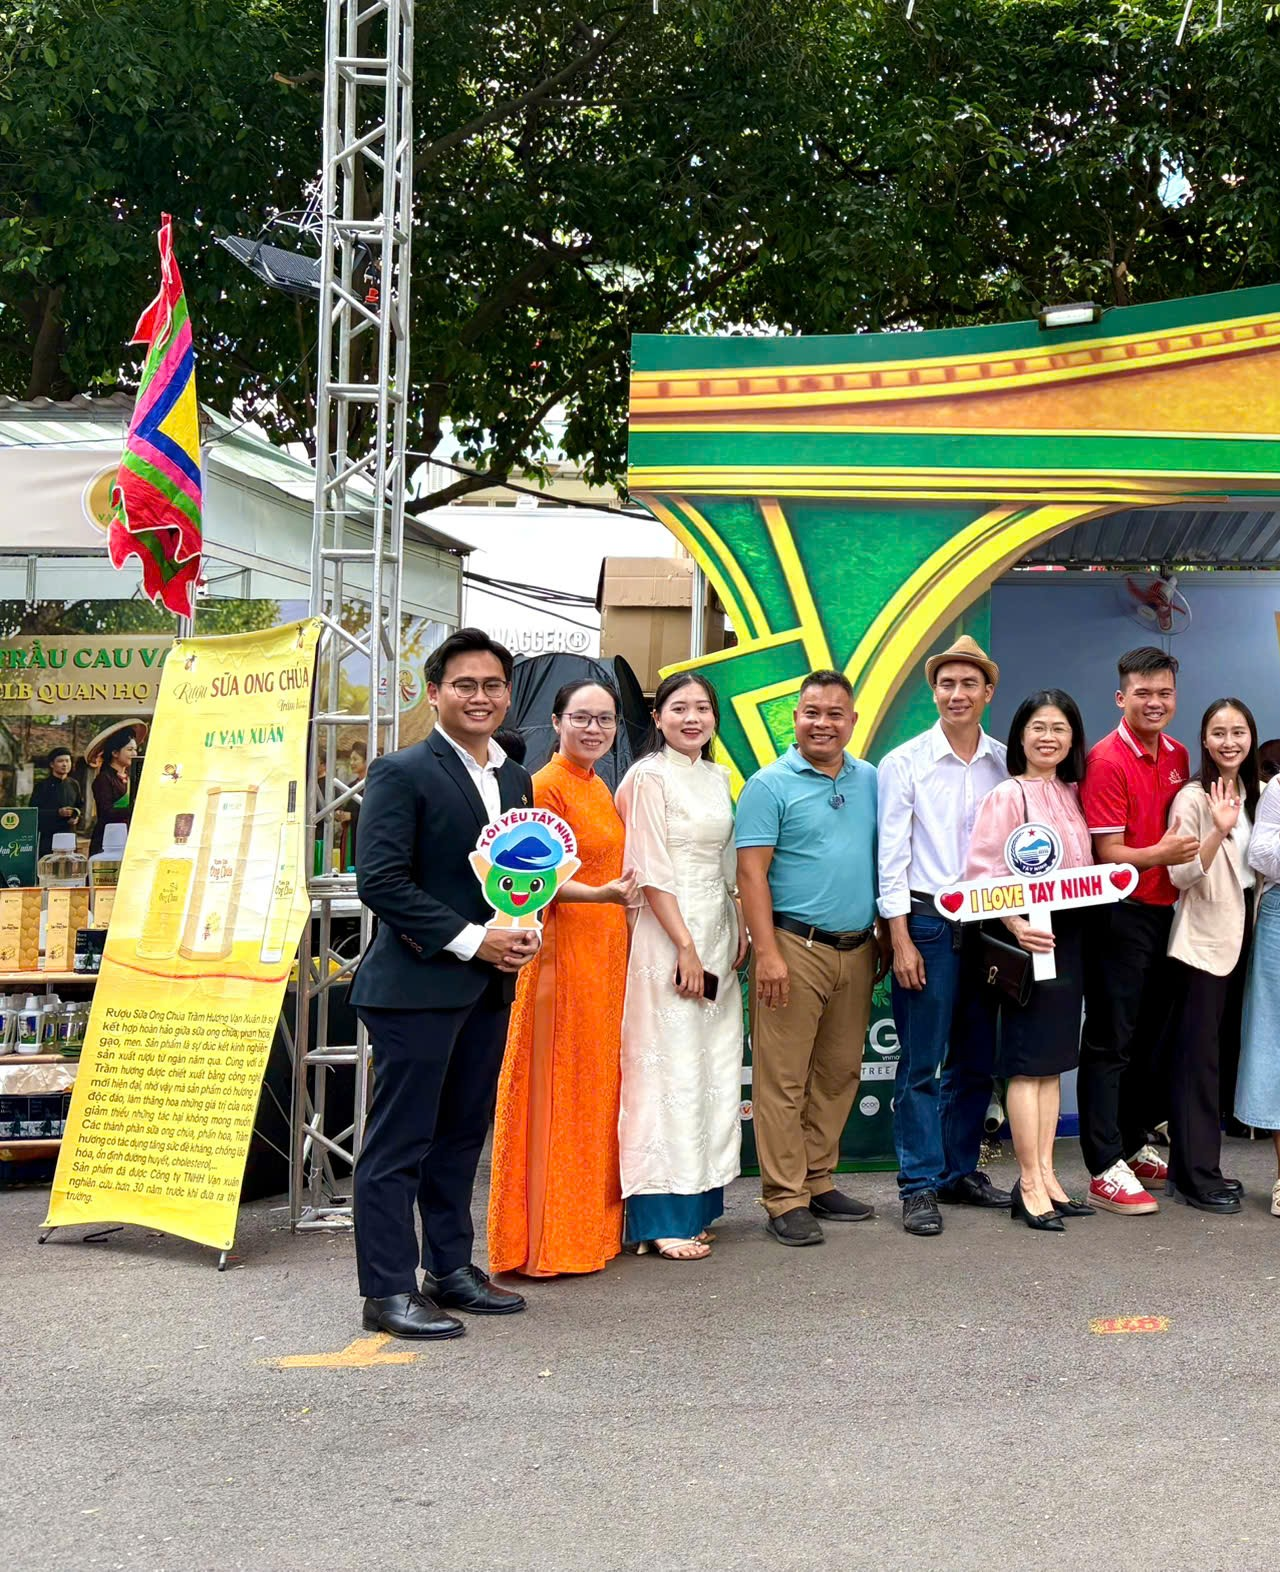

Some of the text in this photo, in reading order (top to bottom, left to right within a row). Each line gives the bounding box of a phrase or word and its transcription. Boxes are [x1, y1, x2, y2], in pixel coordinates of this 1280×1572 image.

[73, 648, 134, 669] CAU
[210, 672, 239, 697] SỮA
[244, 672, 274, 694] ONG
[279, 662, 309, 691] CHÚA
[0, 682, 149, 704] LB QUAN HỌ
[220, 724, 284, 749] VẠN XUÂN
[481, 811, 574, 854] TÔI YÊU TÂY NINH
[970, 875, 1103, 914] I LOVE TAY NINH
[149, 1010, 165, 1022] Ong
[81, 1119, 101, 1130] Các
[132, 1182, 144, 1193] 30
[172, 1172, 181, 1183] ty
[184, 1172, 205, 1183] TNHH
